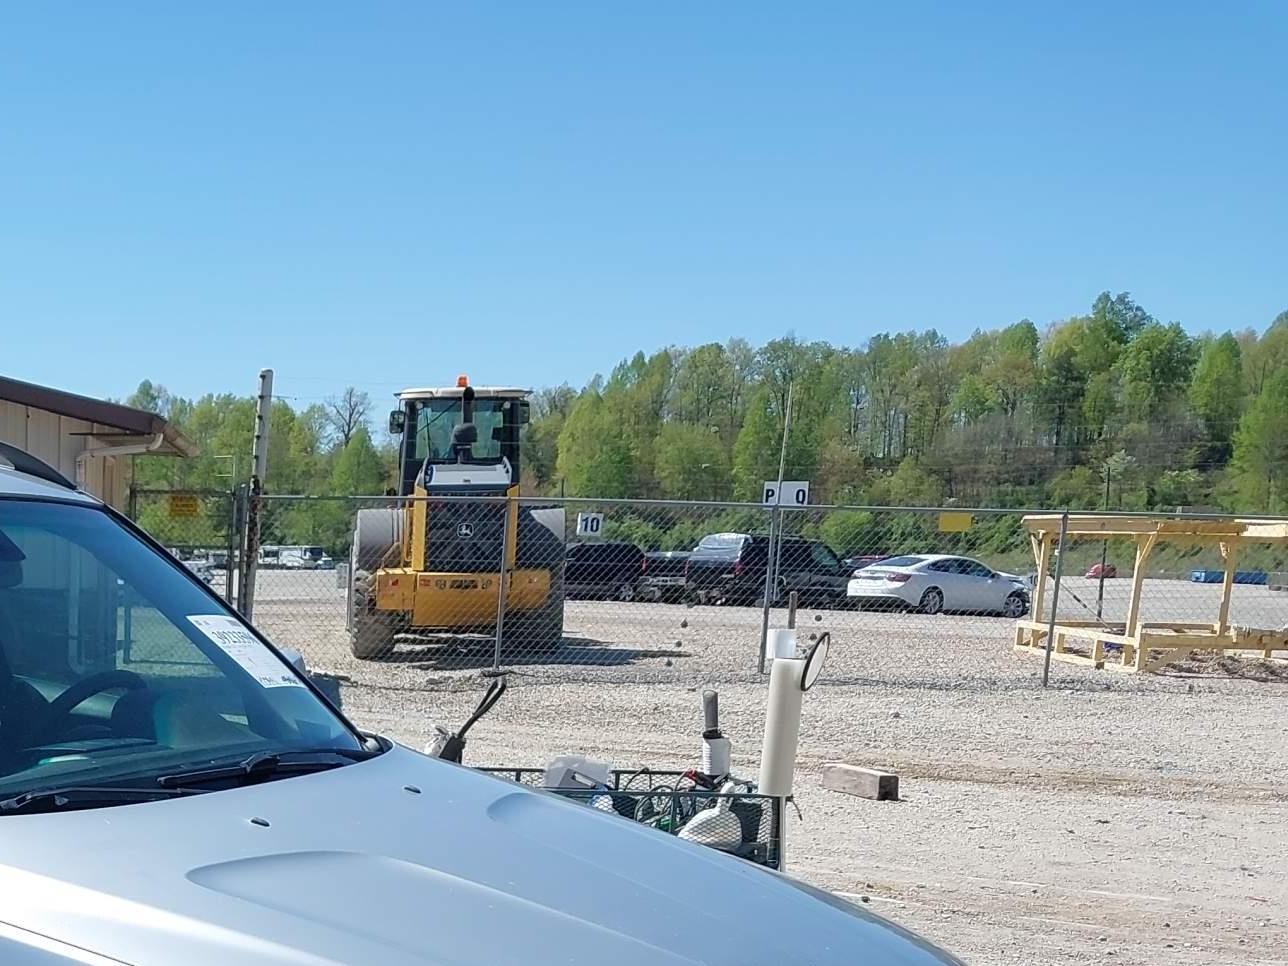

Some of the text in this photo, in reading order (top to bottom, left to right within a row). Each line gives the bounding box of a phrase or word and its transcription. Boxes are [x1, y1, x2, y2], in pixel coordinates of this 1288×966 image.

[765, 488, 806, 505] P Q
[581, 516, 600, 533] 10
